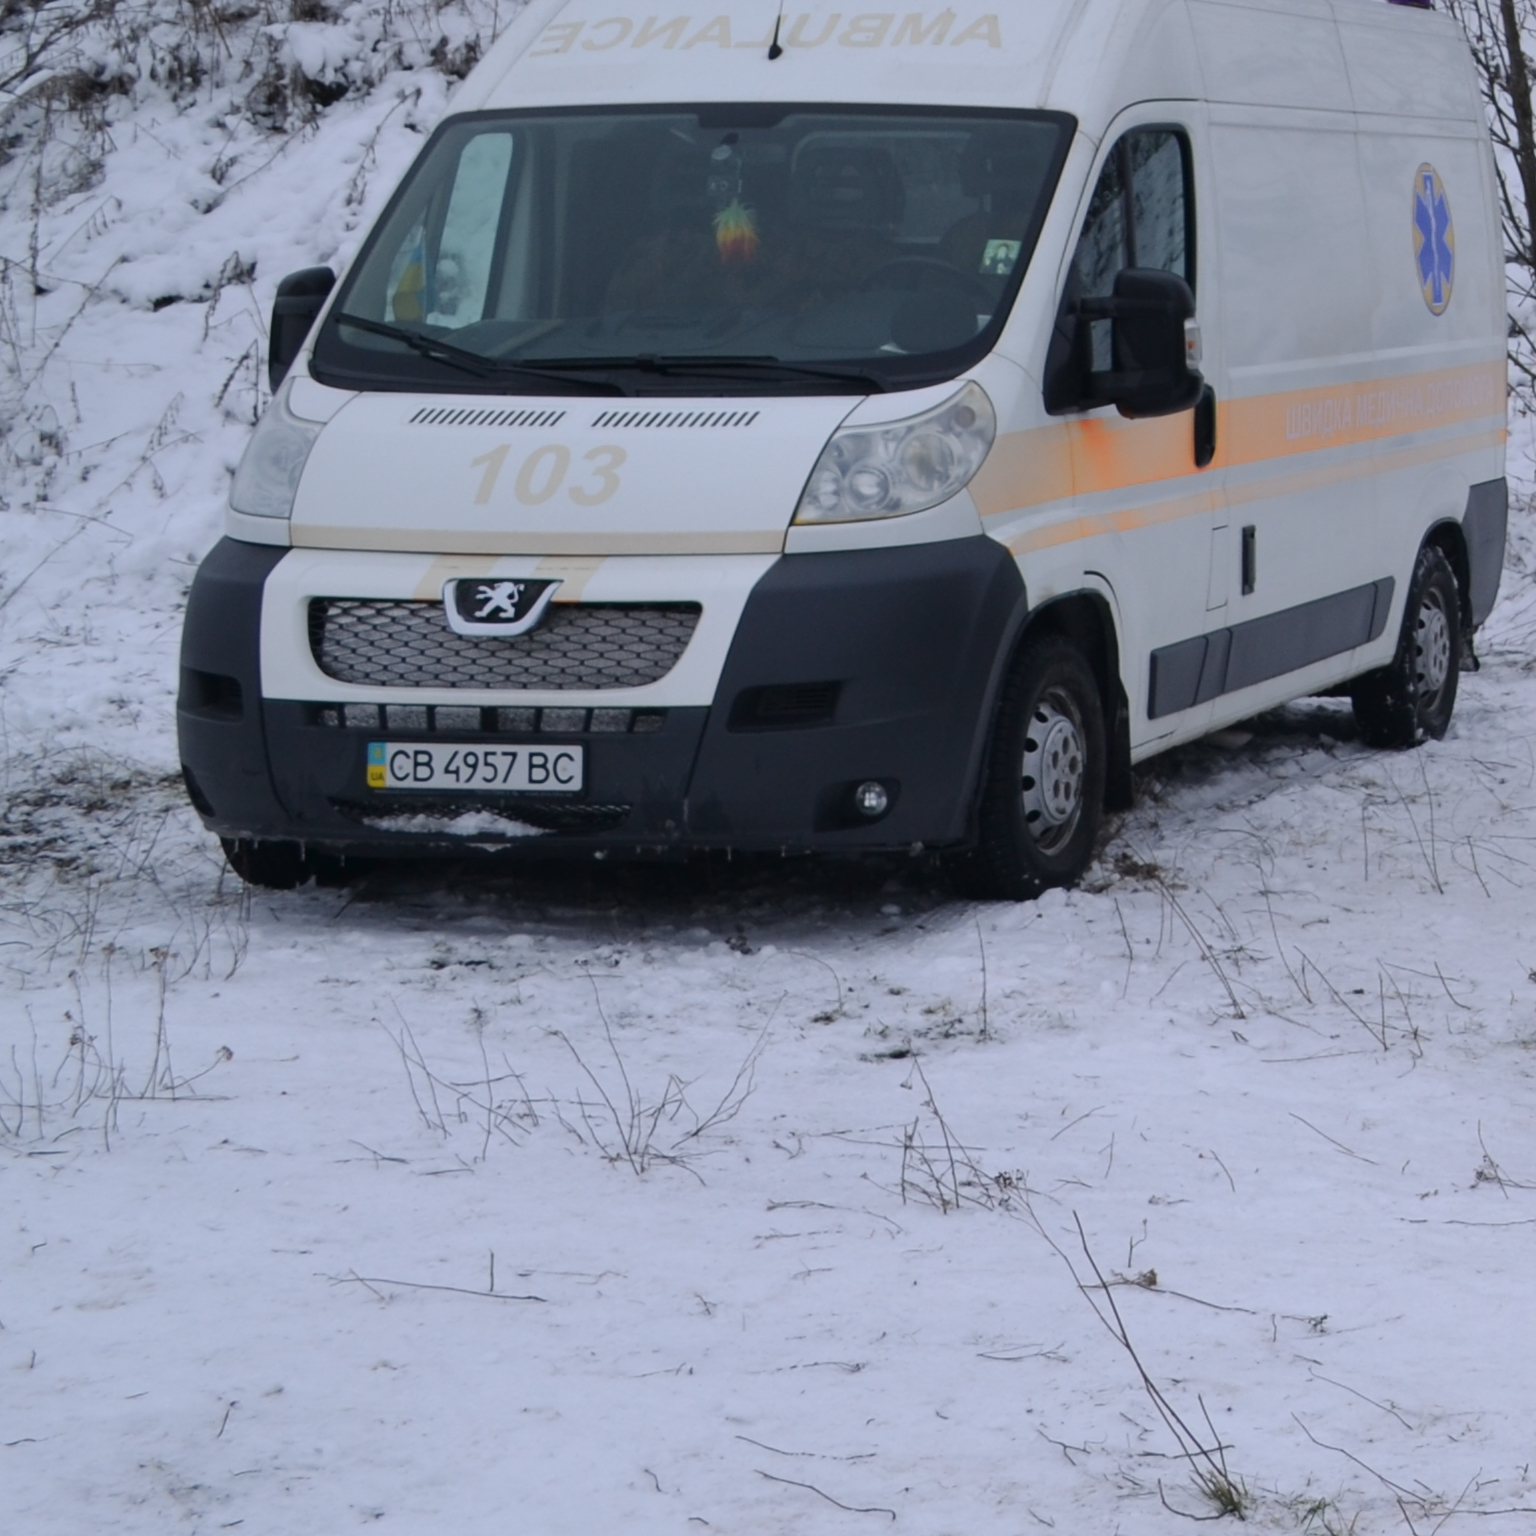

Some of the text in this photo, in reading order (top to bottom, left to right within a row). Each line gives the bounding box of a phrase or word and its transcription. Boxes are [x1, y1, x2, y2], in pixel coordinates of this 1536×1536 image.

[470, 443, 628, 506] 103
[370, 772, 385, 782] UA
[389, 749, 575, 784] CB 4957 BC
